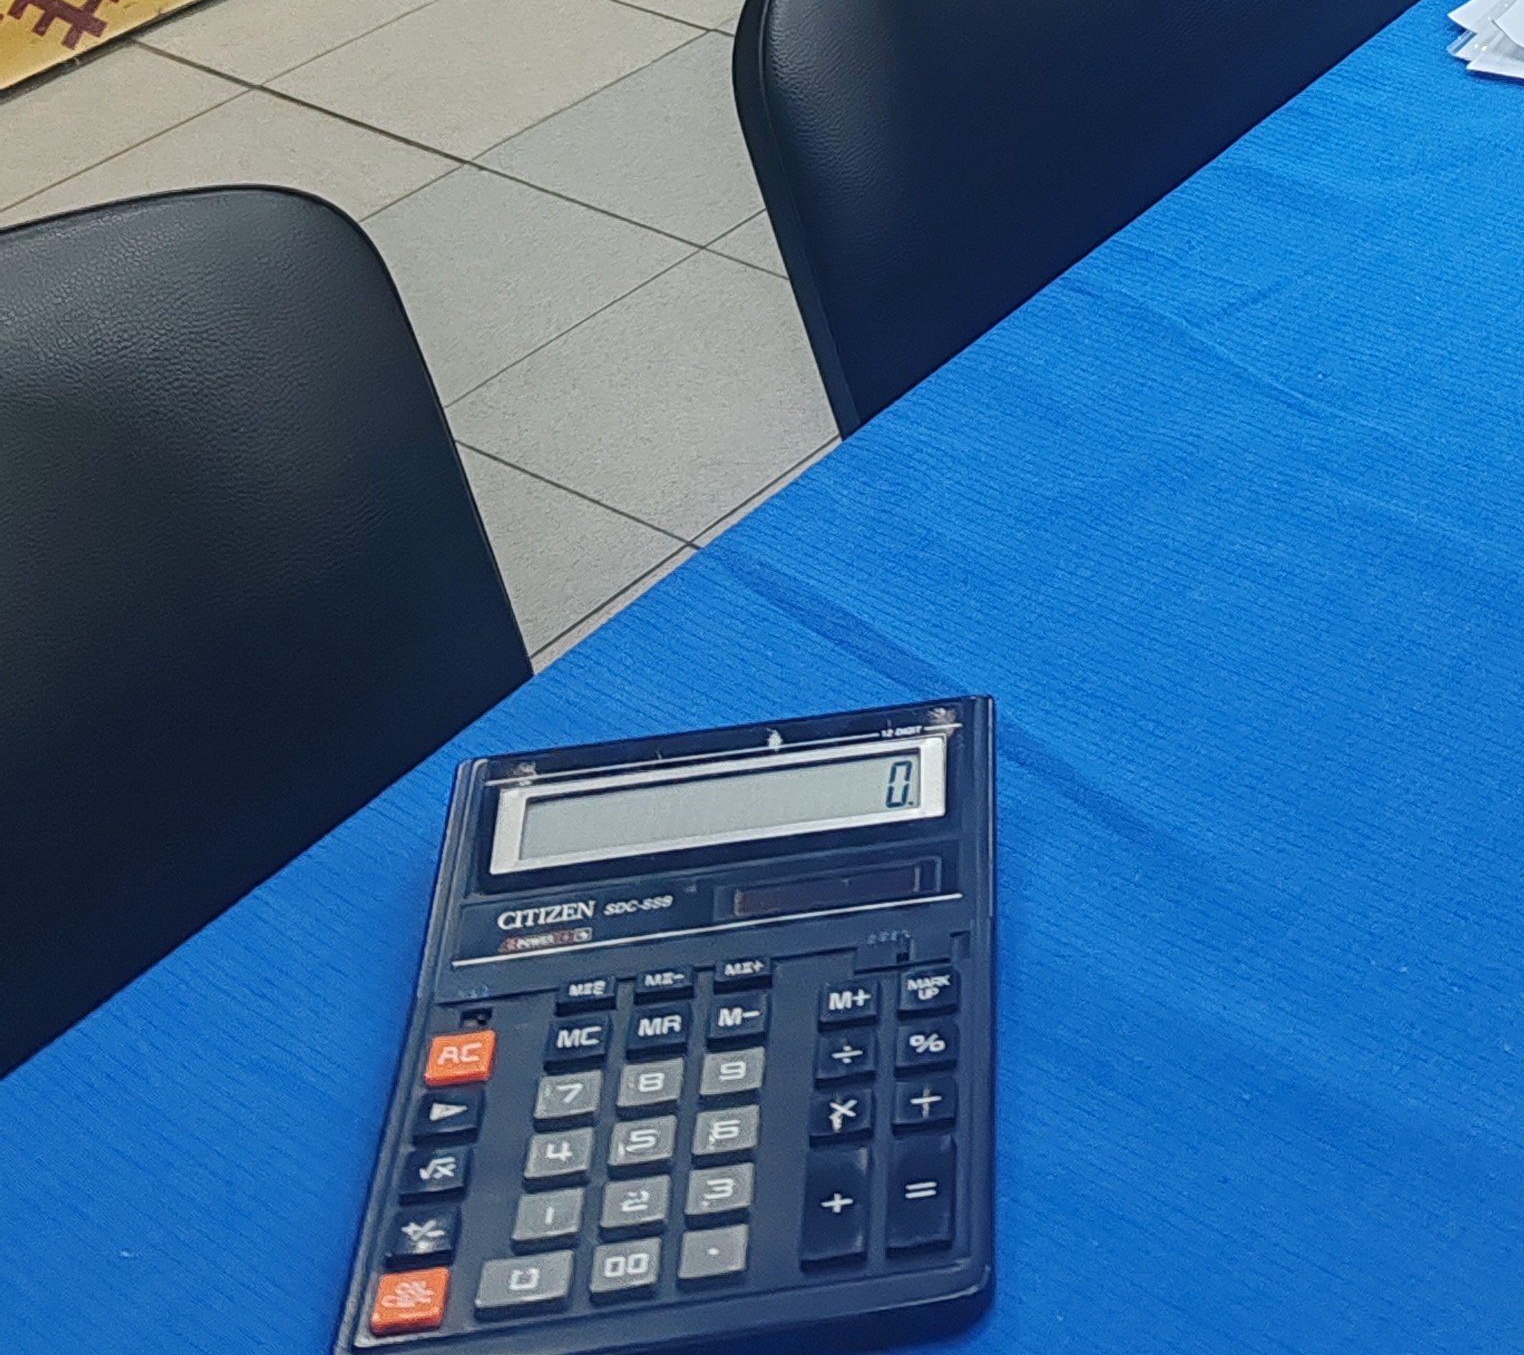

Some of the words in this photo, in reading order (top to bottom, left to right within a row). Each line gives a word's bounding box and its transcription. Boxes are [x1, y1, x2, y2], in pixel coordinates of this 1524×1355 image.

[498, 900, 596, 930] CITIZEN
[907, 975, 950, 991] MARK
[918, 988, 940, 1000] UP
[556, 1026, 602, 1048] MC
[638, 1014, 682, 1036] MR
[829, 989, 871, 1010] M+
[437, 1042, 482, 1065] AC
[556, 1083, 583, 1103] 7
[639, 1072, 664, 1091] 8
[719, 1061, 746, 1080] 9
[545, 1141, 573, 1162] 4
[626, 1129, 660, 1152] 5
[711, 1119, 741, 1141] 6
[545, 1207, 554, 1225] 1
[621, 1190, 650, 1212] 2
[704, 1178, 735, 1200] 3
[604, 1253, 650, 1277] 00
